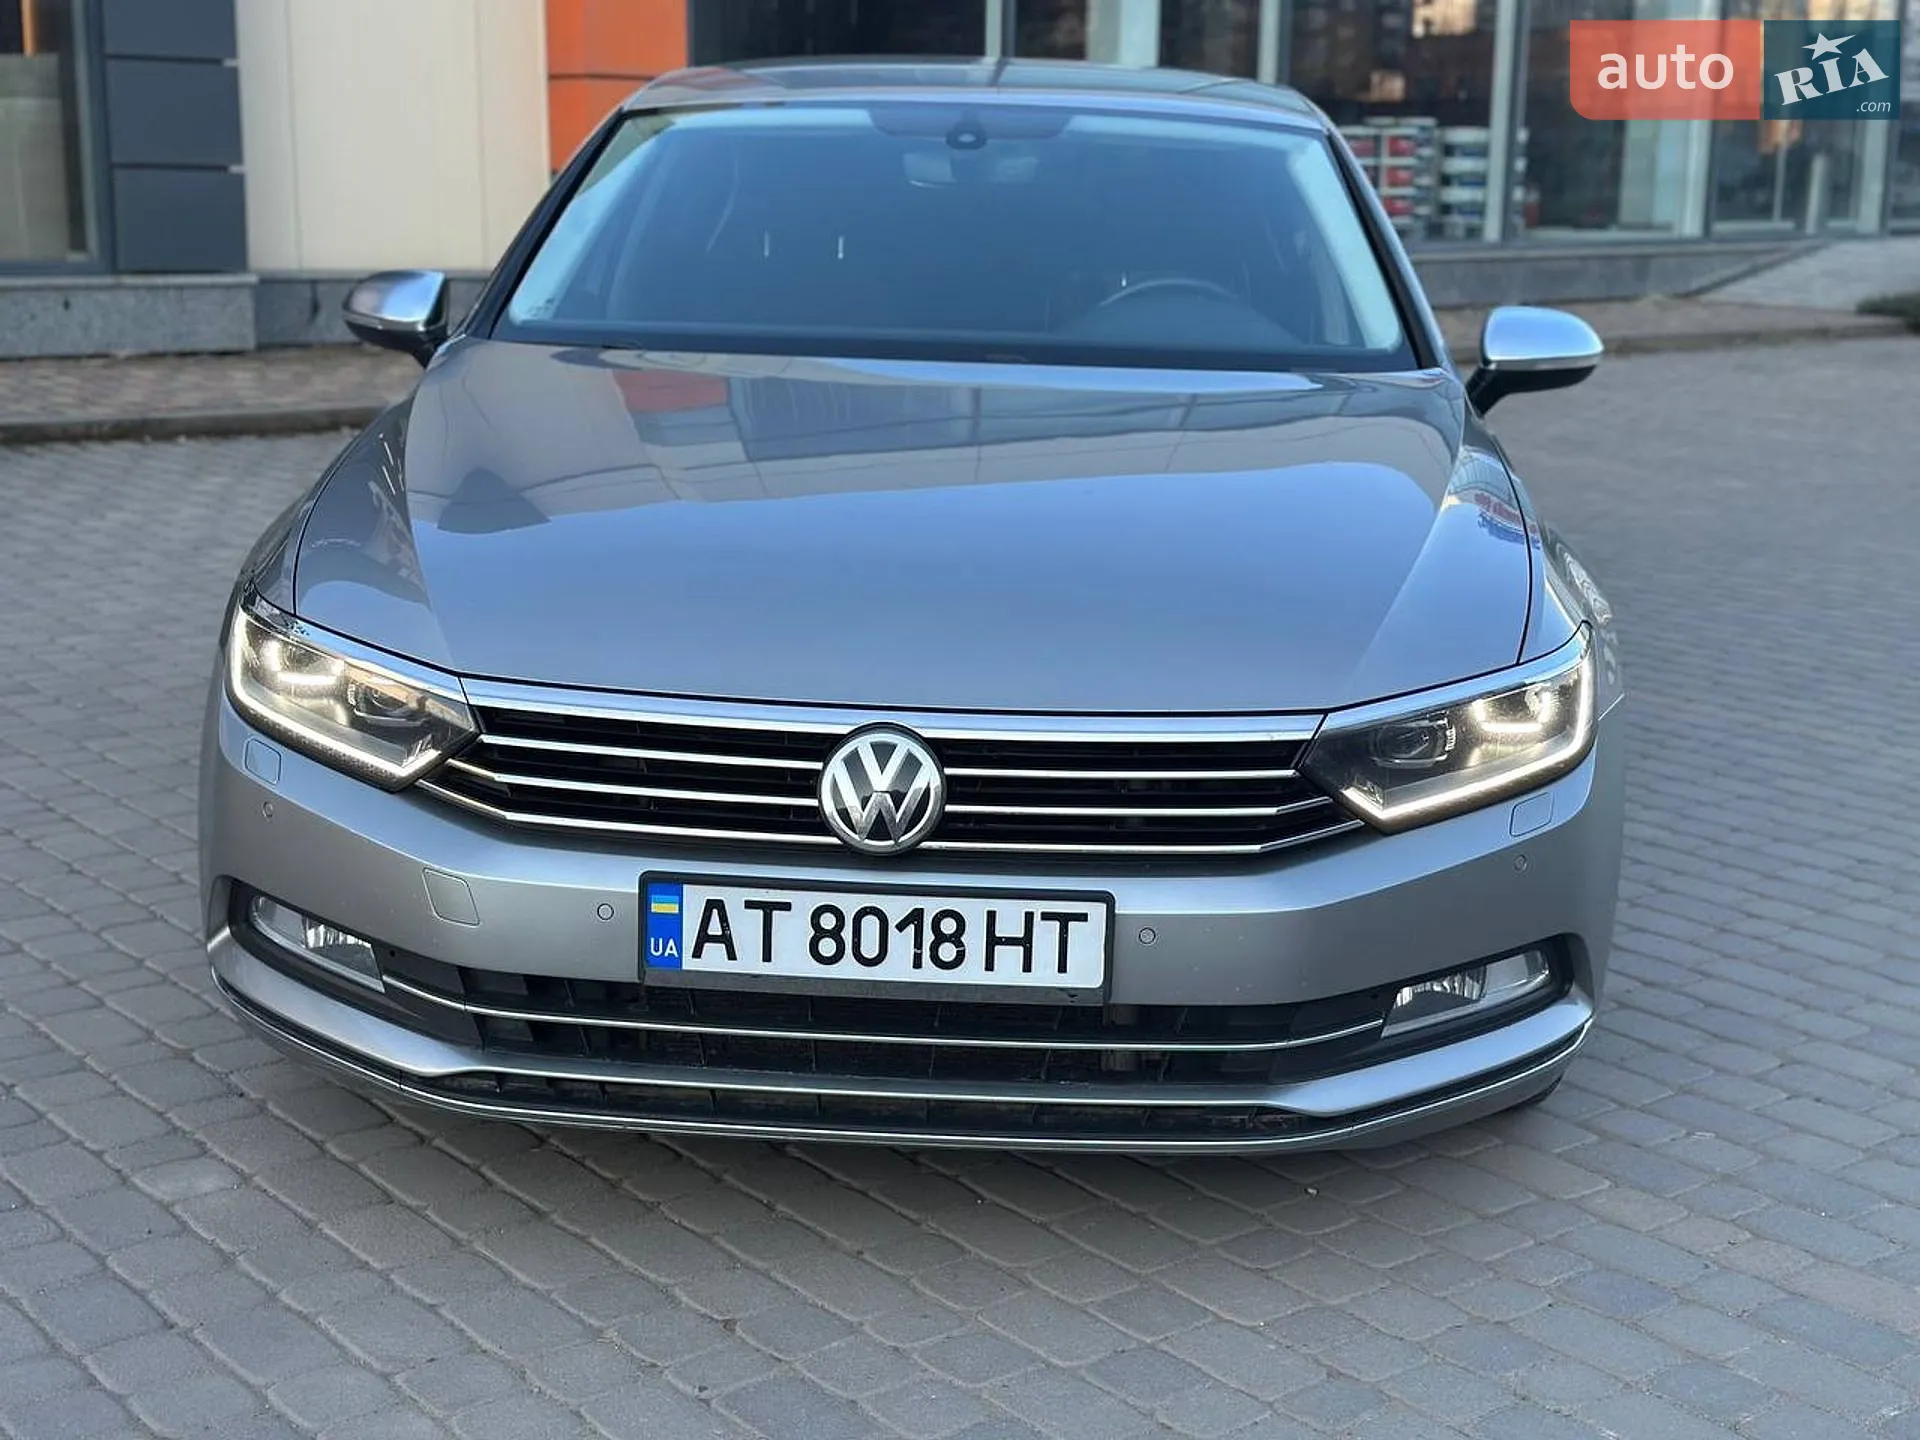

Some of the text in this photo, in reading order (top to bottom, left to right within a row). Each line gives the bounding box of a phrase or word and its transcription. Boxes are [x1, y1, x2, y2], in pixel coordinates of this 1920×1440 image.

[825, 735, 938, 848] VW
[649, 937, 680, 958] UA
[691, 898, 1089, 974] AT 8018 HT
